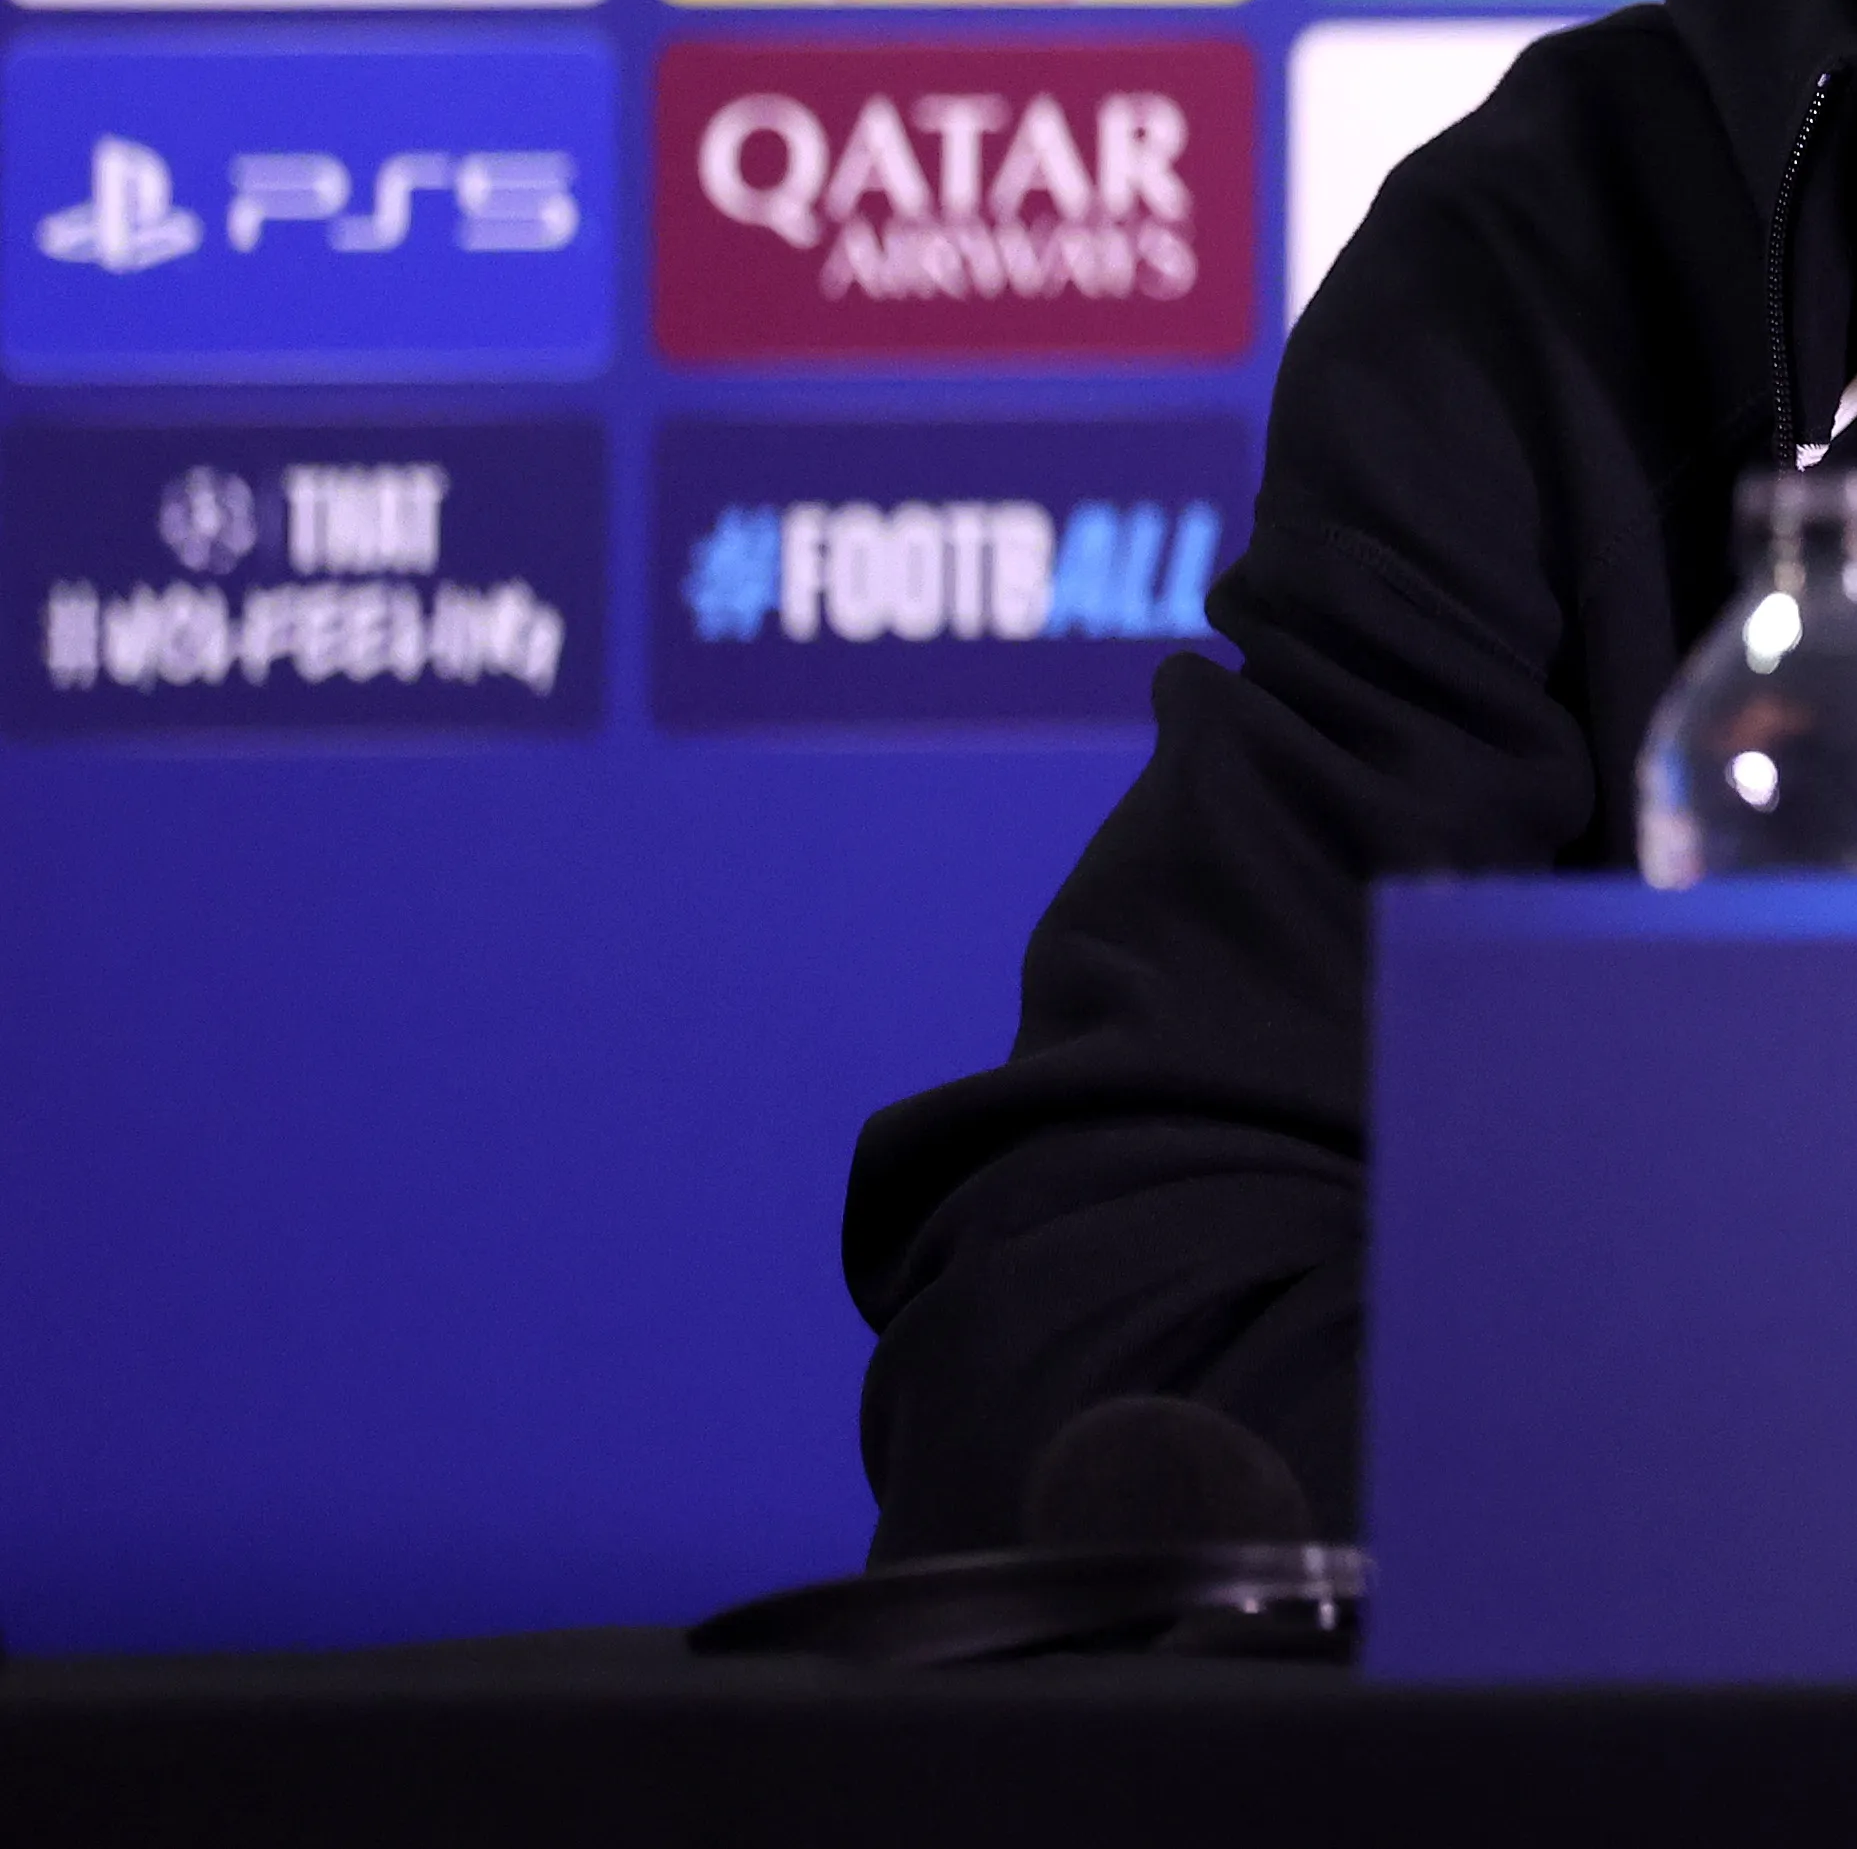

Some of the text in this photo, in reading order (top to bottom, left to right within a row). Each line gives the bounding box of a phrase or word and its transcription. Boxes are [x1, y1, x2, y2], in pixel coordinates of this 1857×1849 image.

[228, 150, 579, 254] PS5
[698, 93, 1190, 250] QATAR
[821, 216, 1198, 303] AIRWAYS
[680, 497, 1220, 642] #FOOTBALL
